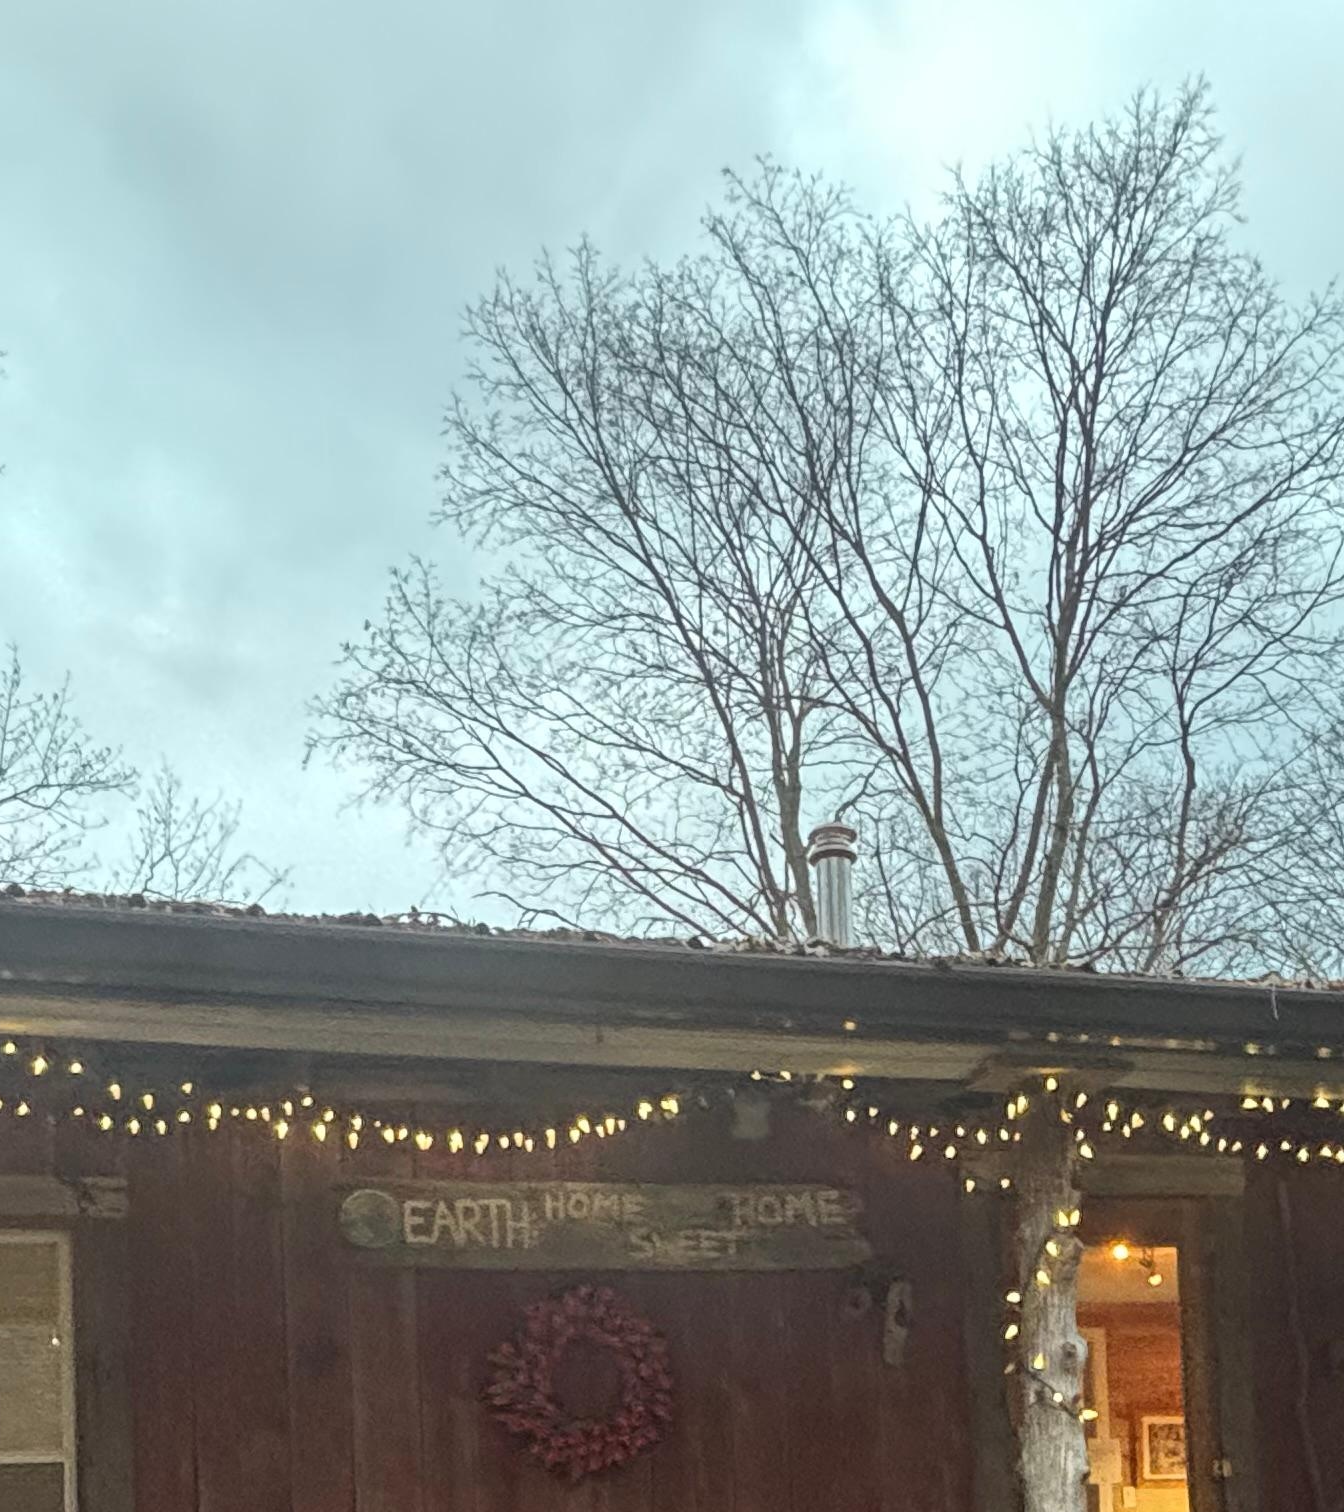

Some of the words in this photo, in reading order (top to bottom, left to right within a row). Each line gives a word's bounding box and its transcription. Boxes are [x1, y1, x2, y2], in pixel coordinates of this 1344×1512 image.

[403, 1199, 540, 1248] EARTH
[545, 1192, 643, 1221] HOME
[629, 1229, 749, 1259] SWEET
[734, 1190, 848, 1226] HOME
